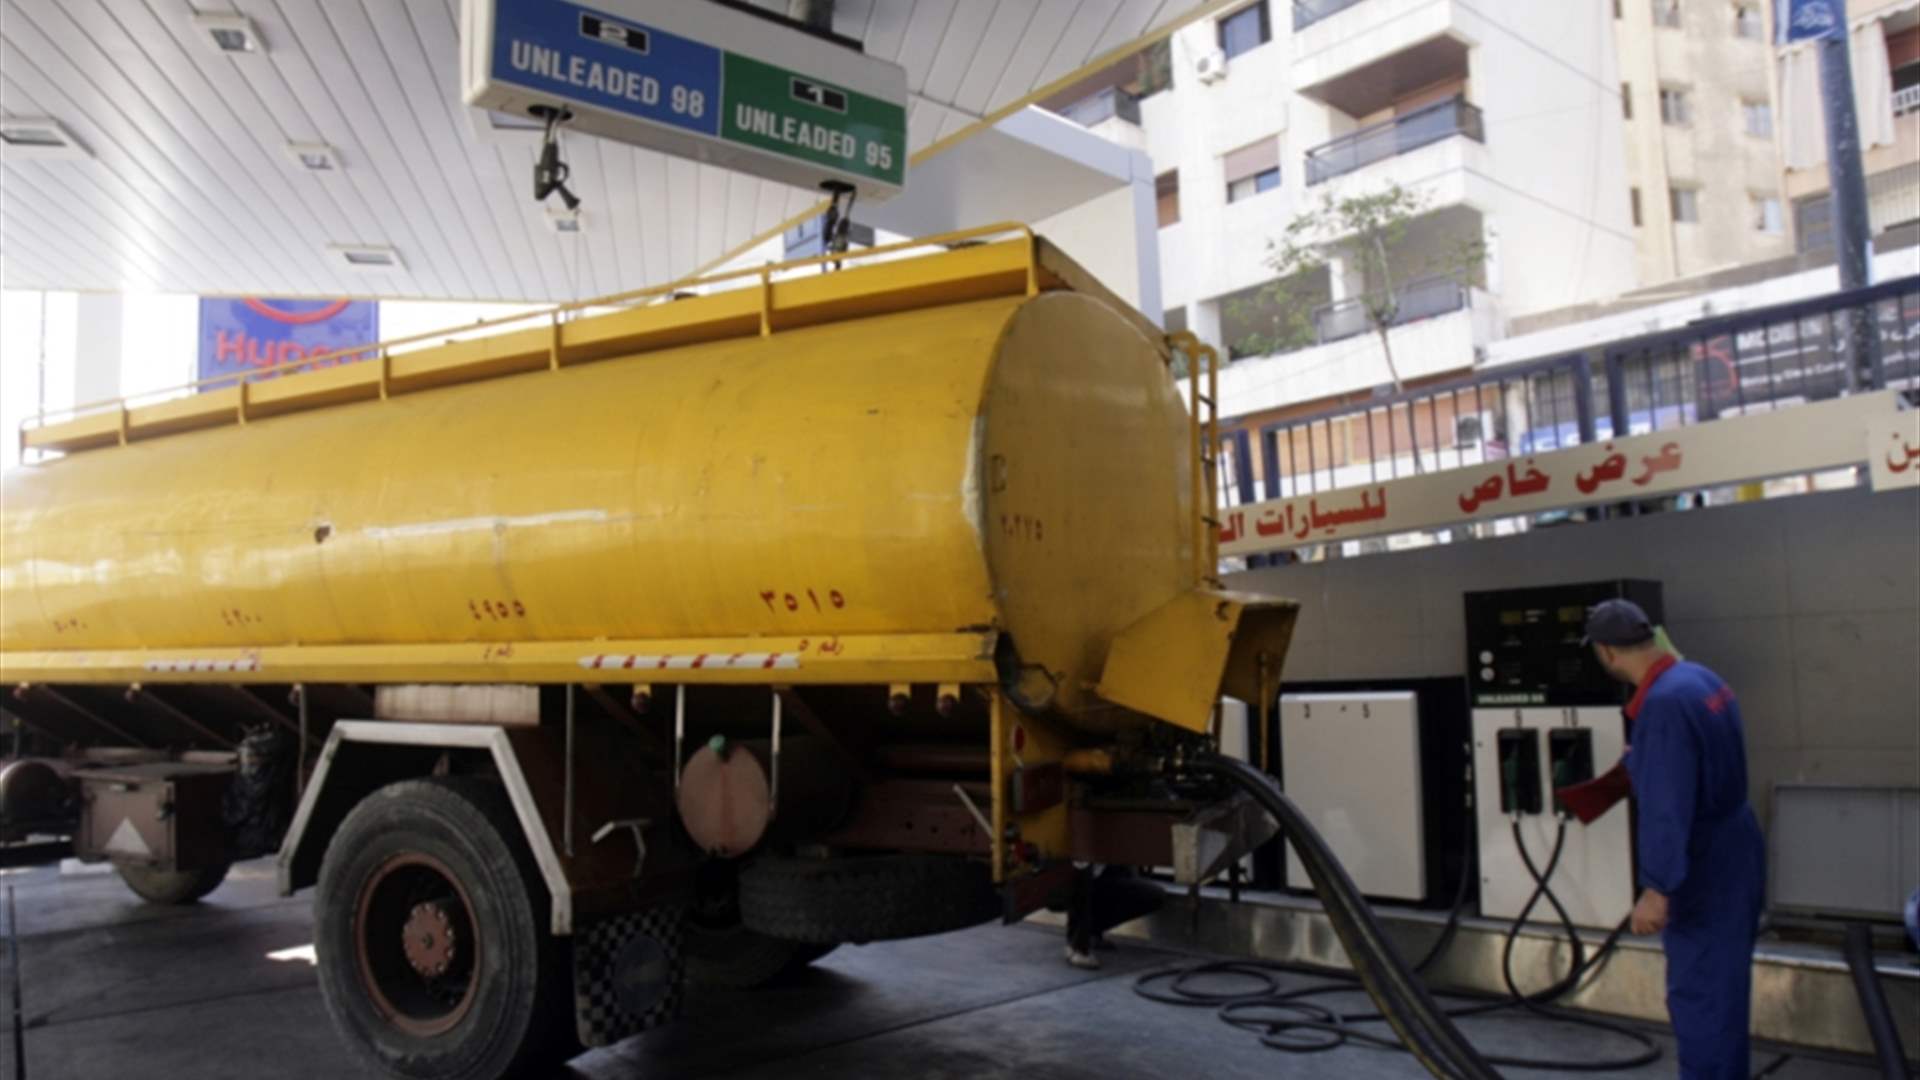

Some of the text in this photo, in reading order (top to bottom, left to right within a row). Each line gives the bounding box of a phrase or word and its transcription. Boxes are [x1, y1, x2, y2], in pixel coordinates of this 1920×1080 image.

[599, 21, 628, 44] 2
[511, 39, 705, 118] UNLEADED 98
[807, 86, 825, 104] 1
[735, 103, 893, 170] UNLEADED 95
[1457, 459, 1551, 514] خاص
[1576, 443, 1683, 494] عرض
[1256, 487, 1387, 541] للسيارات
